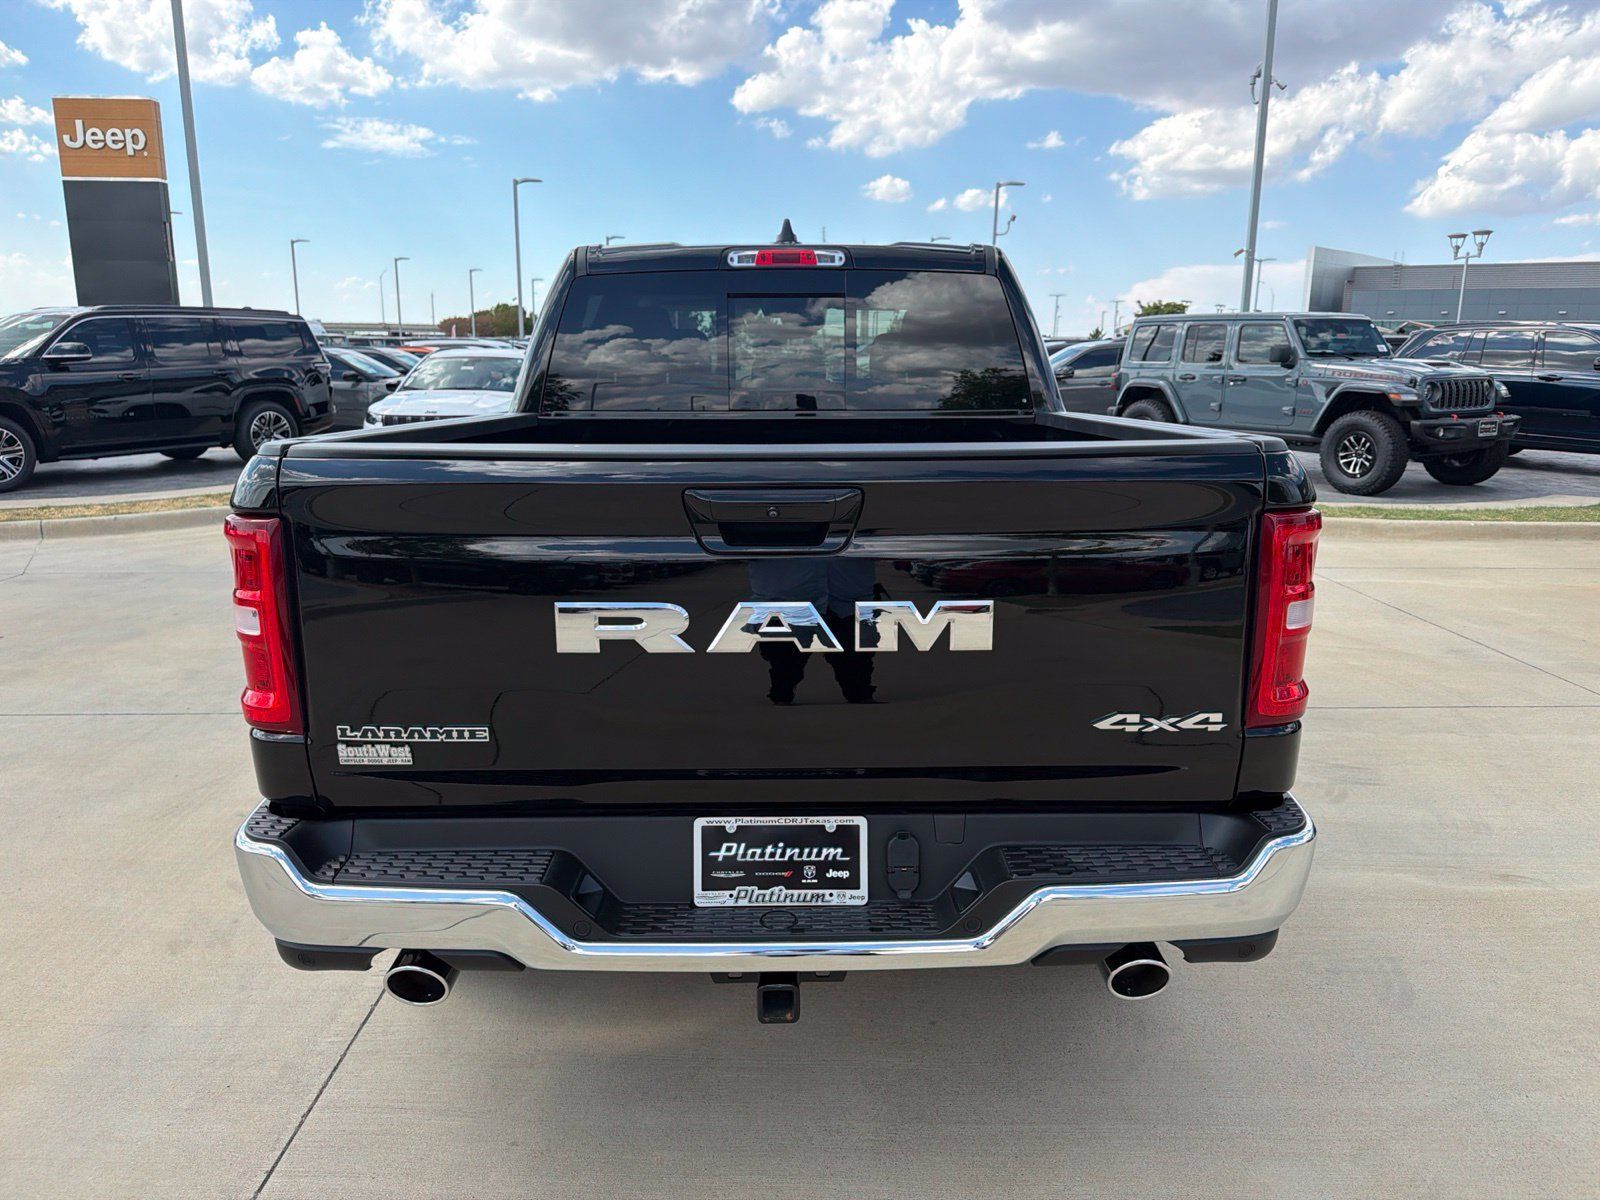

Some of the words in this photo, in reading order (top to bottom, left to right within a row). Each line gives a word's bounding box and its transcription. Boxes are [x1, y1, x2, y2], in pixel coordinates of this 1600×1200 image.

[62, 119, 147, 156] Jeep
[554, 600, 994, 653] RAM
[1092, 712, 1229, 732] 4x4
[336, 725, 490, 742] LARAMIE
[337, 743, 412, 757] SouthWest
[705, 817, 855, 825] www.PlatinumCDRJTexas.com
[708, 842, 851, 862] Platinum
[825, 868, 850, 879] Jeep
[734, 887, 834, 905] Platinum
